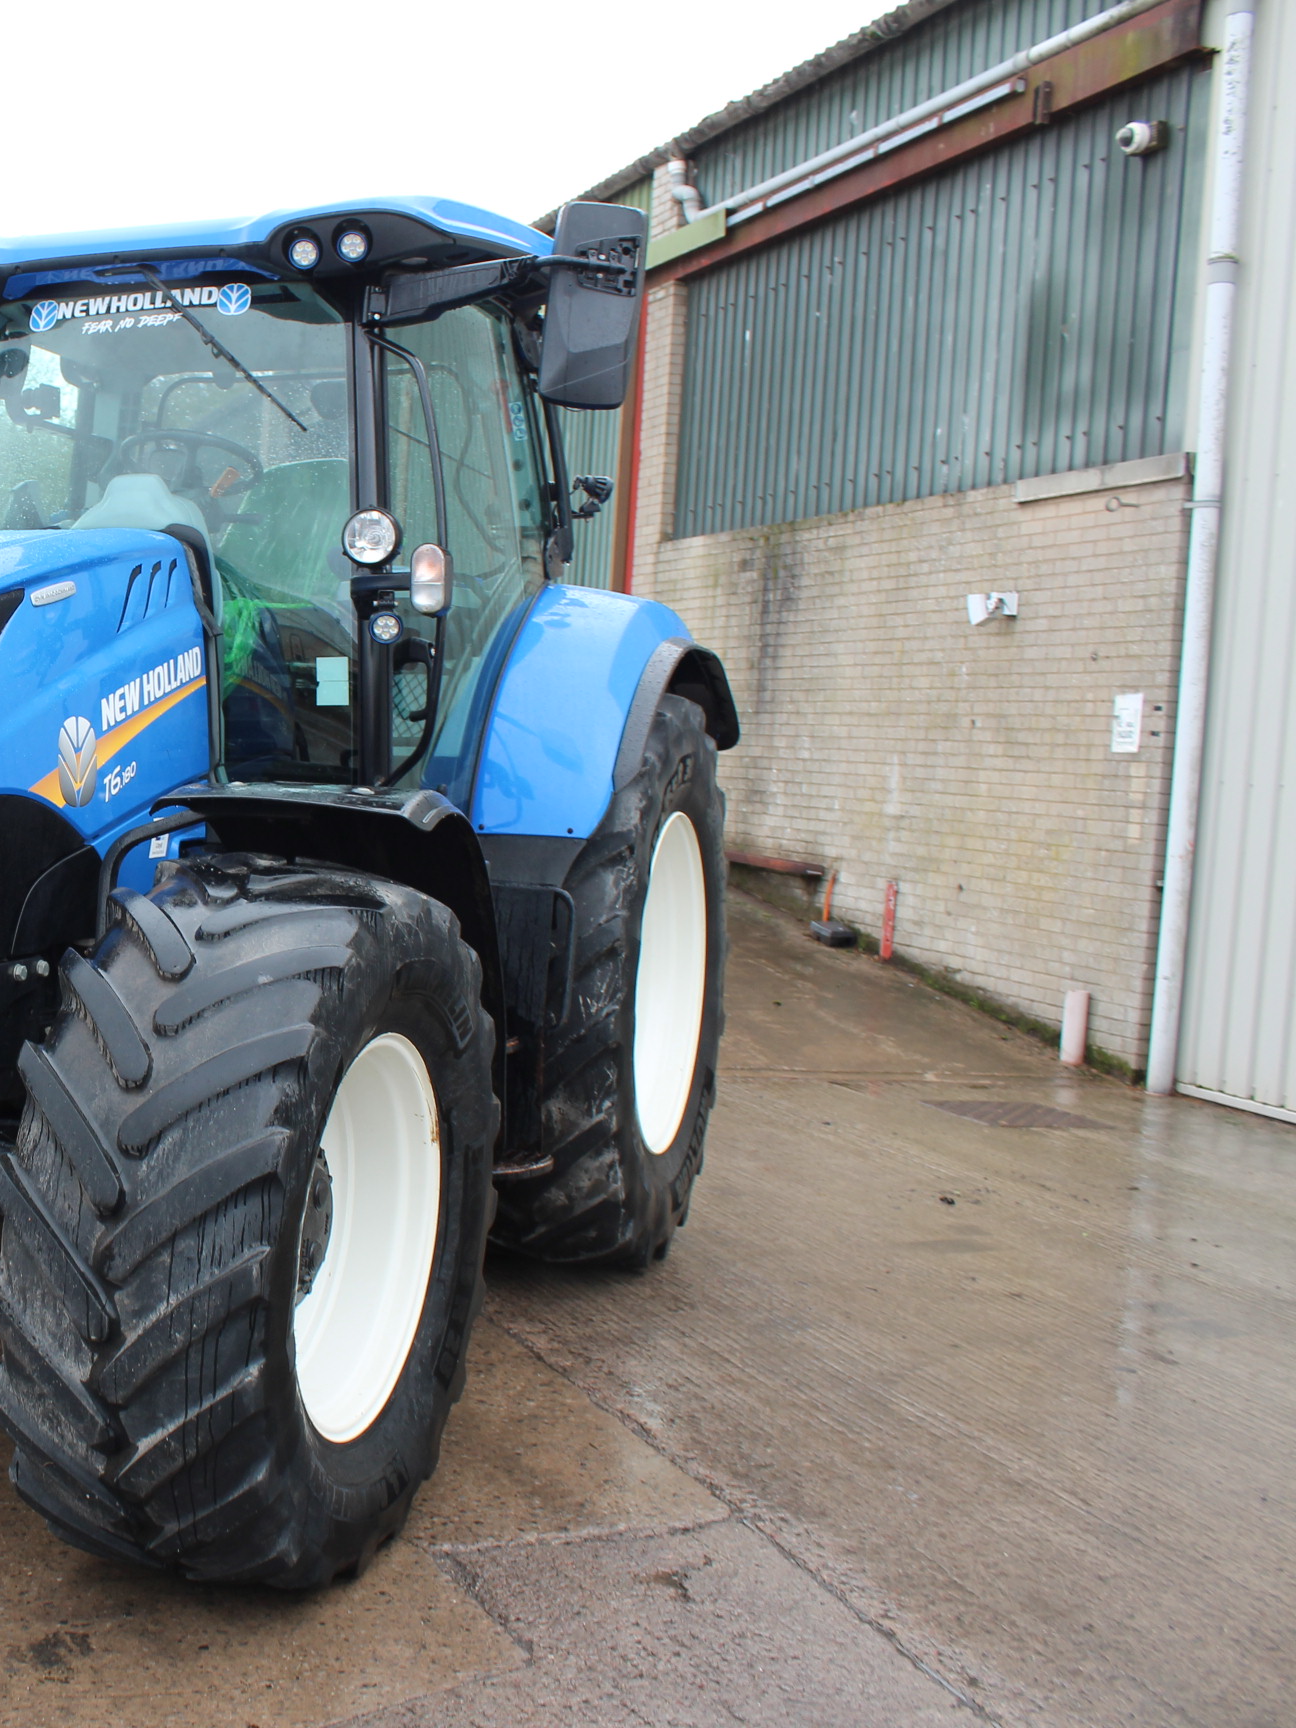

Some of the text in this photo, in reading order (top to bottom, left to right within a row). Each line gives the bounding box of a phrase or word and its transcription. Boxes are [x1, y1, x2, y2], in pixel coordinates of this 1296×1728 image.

[82, 319, 113, 335] FEAR
[114, 316, 135, 333] NO
[101, 646, 202, 731] NEW HOLLAND
[103, 761, 137, 803] T6.180
